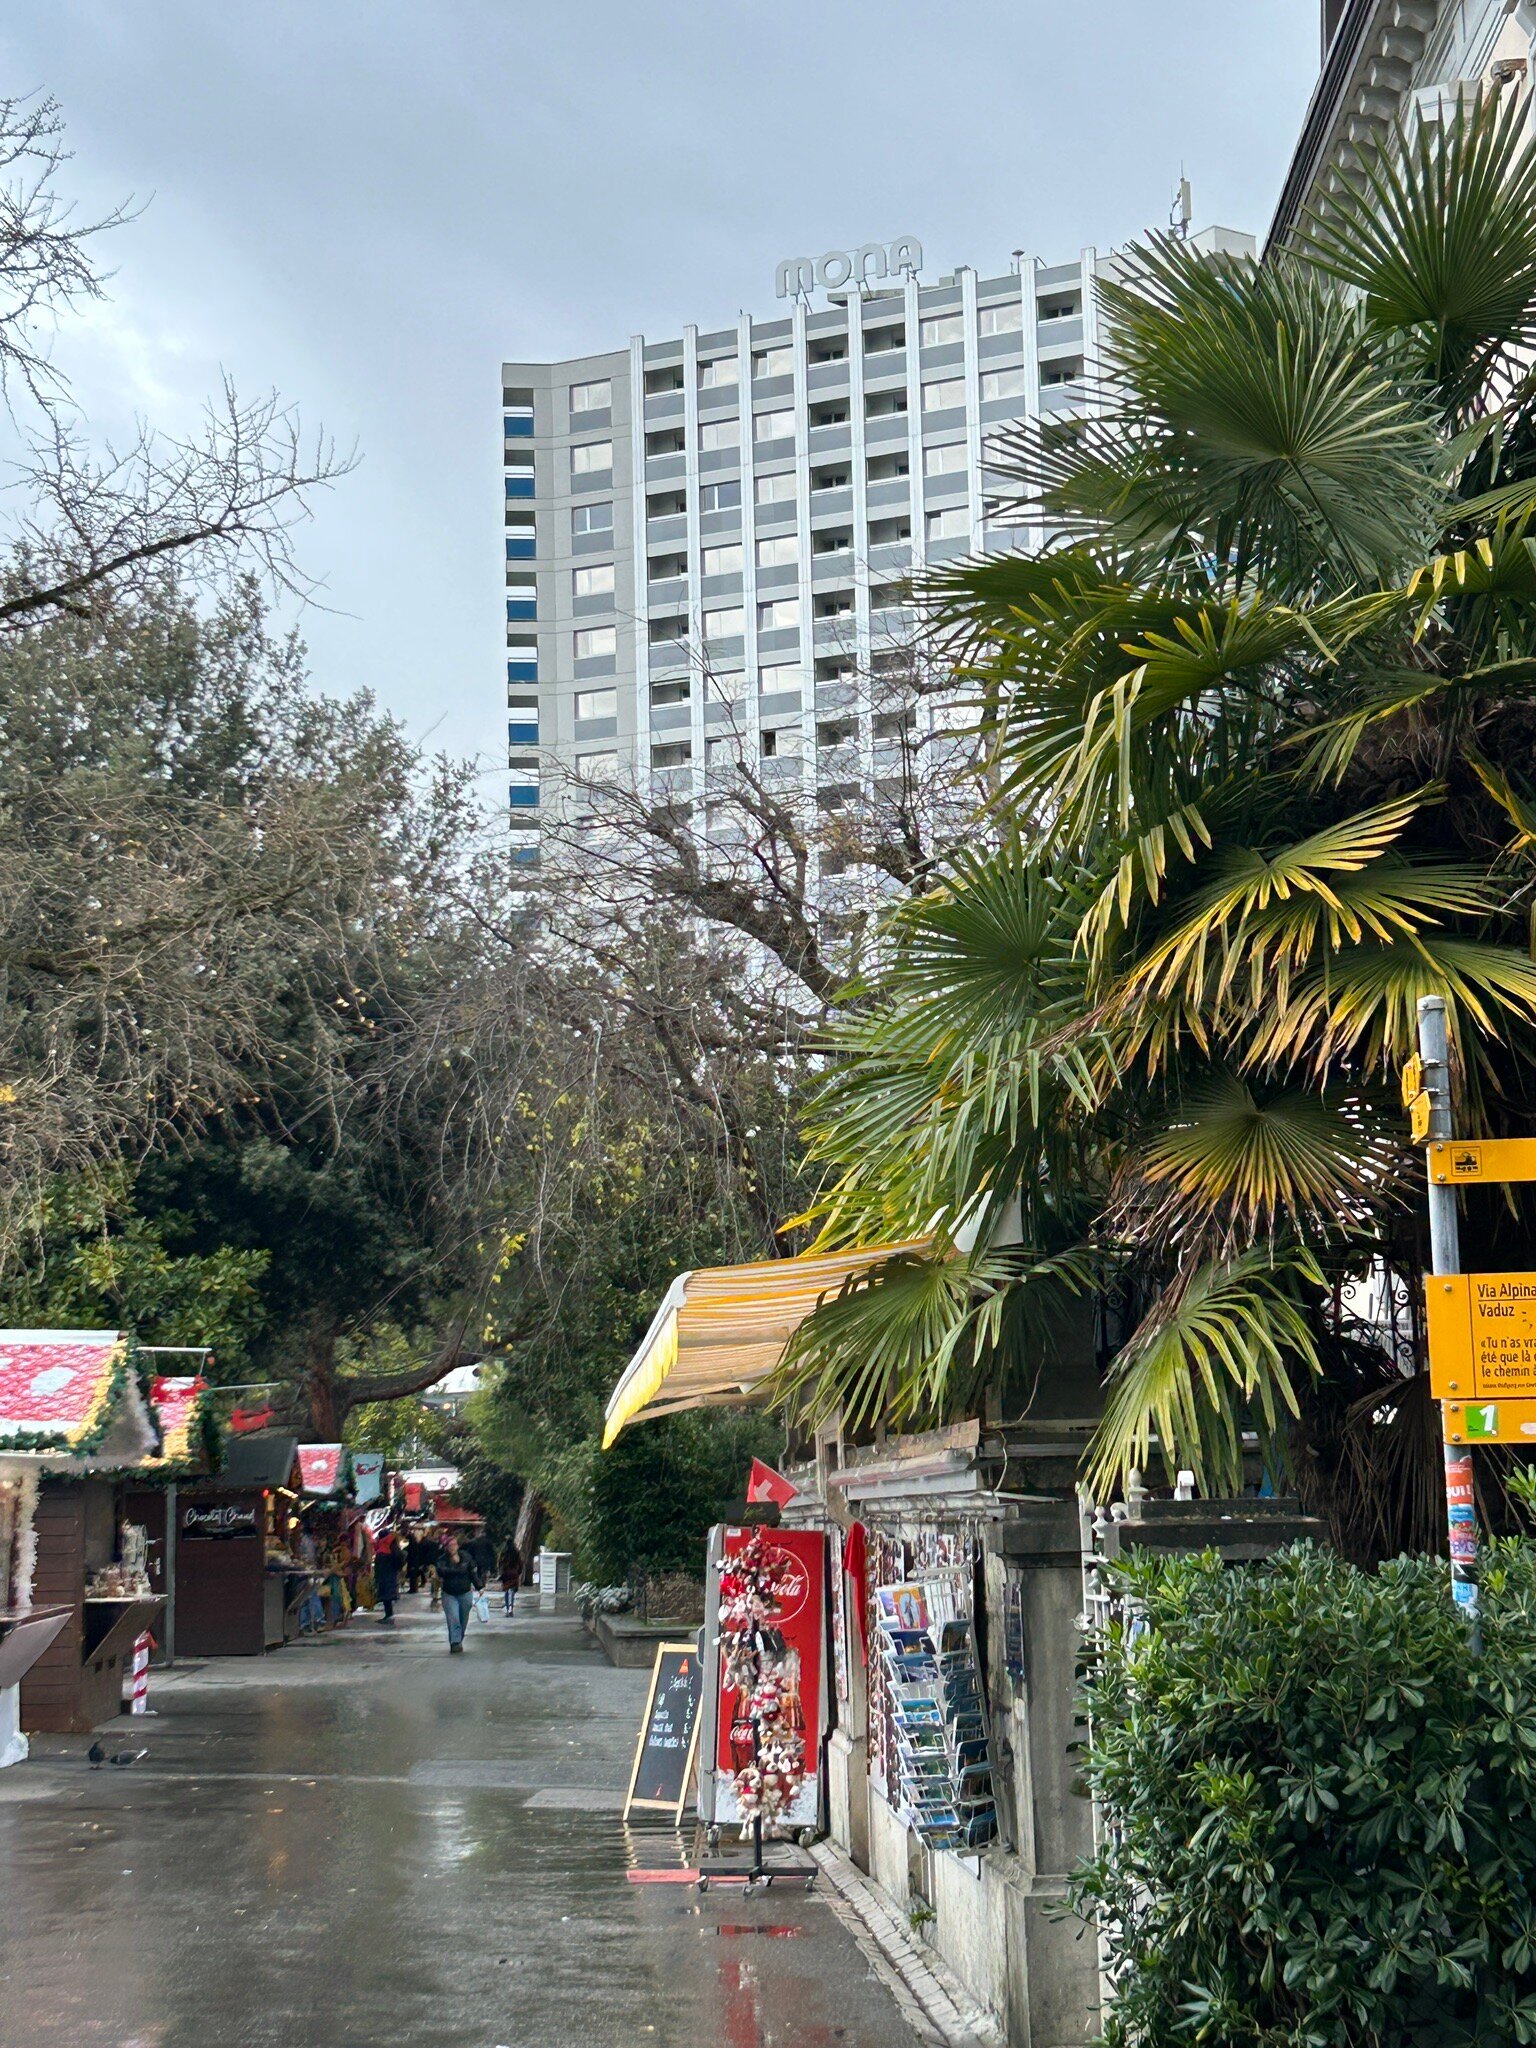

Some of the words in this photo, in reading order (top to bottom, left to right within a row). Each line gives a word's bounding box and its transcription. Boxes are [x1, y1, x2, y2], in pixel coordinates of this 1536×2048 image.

[1477, 1284, 1496, 1298] Via
[1500, 1283, 1536, 1300] Alpina
[1478, 1302, 1515, 1317] Vaduz
[1481, 1351, 1497, 1363] été
[1500, 1353, 1519, 1366] que
[1522, 1350, 1531, 1362] là
[1482, 1365, 1491, 1377] le
[1494, 1365, 1530, 1377] chemin
[1479, 1405, 1495, 1432] 1
